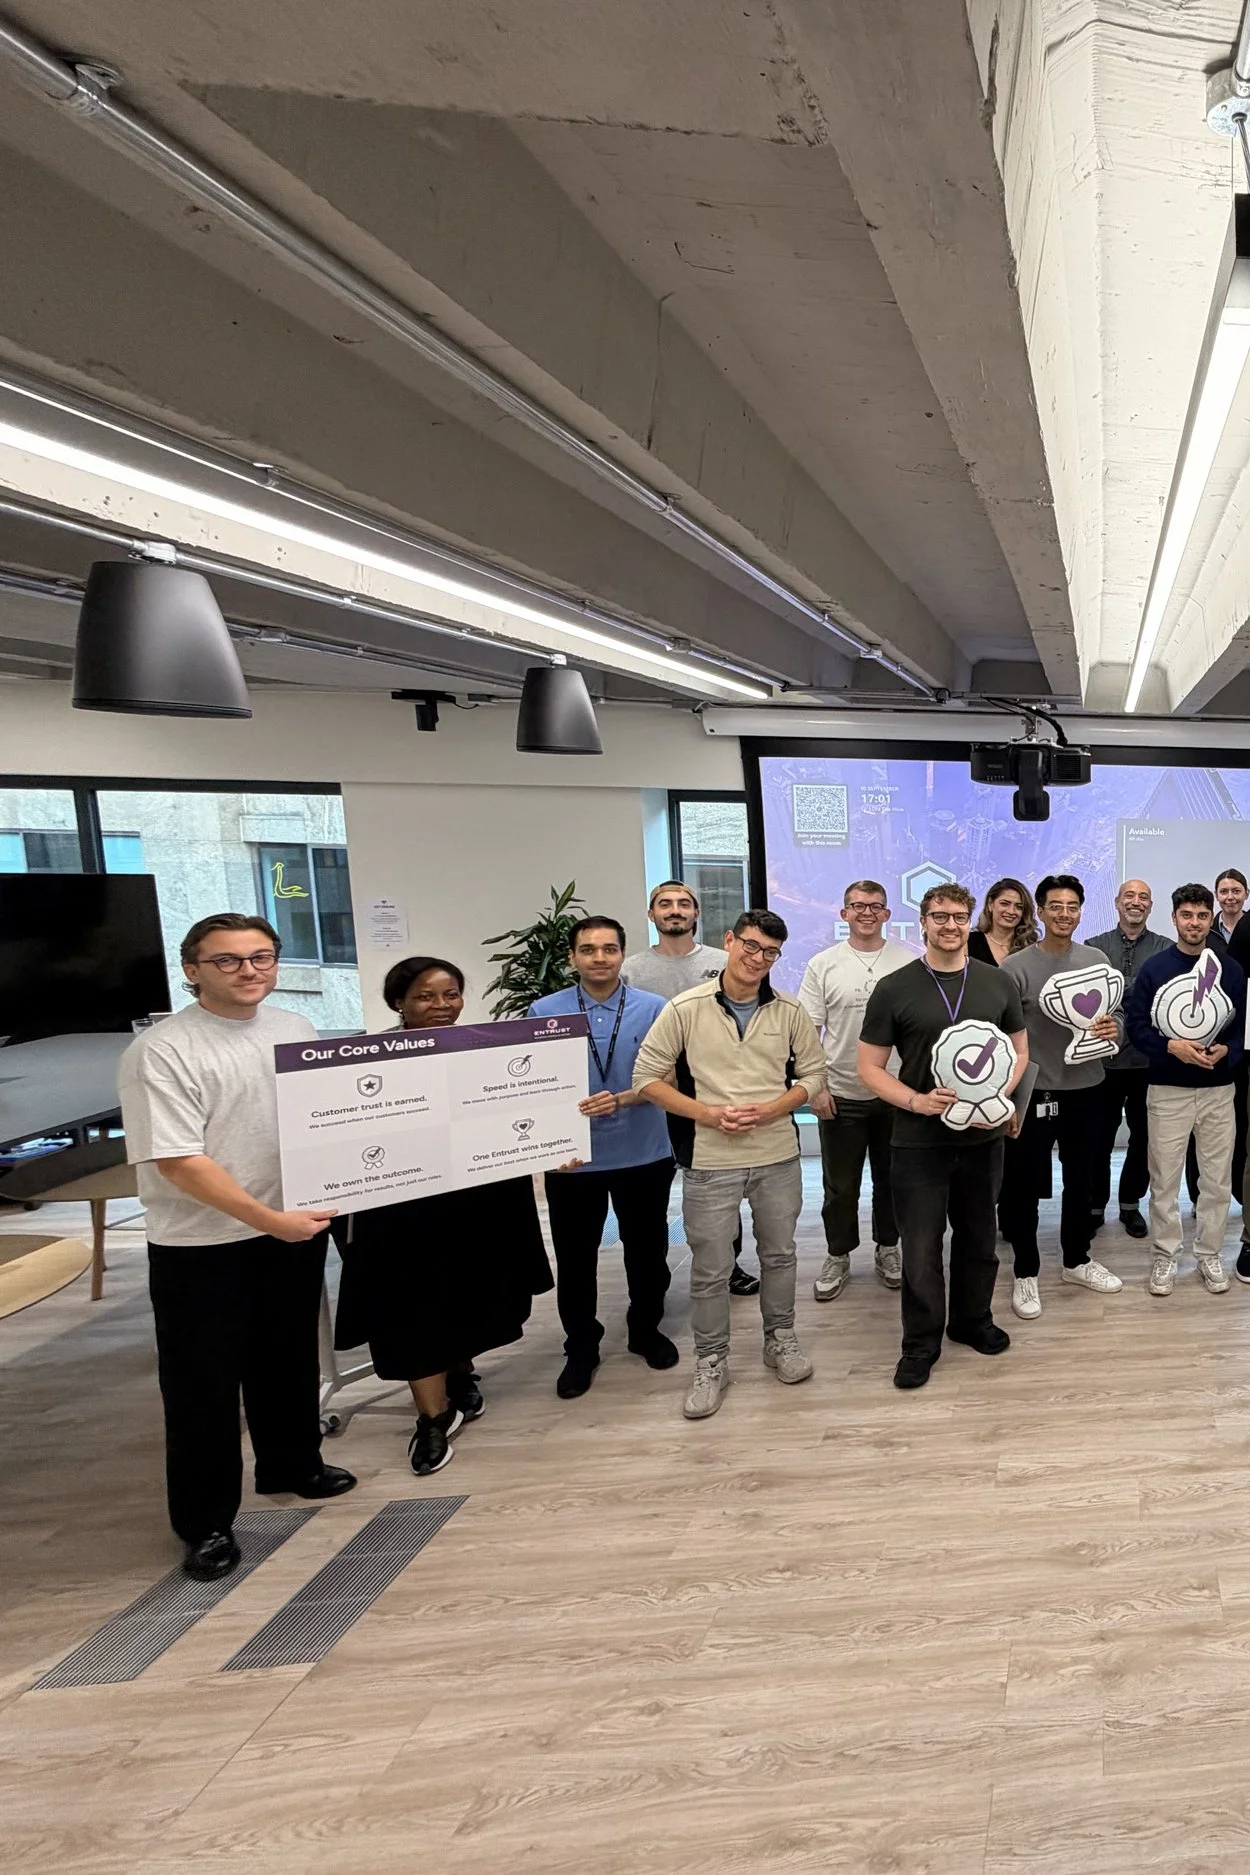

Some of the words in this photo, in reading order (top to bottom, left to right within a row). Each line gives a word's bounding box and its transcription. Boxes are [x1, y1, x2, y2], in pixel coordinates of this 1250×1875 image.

[861, 794, 891, 803] 17:01
[1129, 828, 1165, 836] Available
[534, 1027, 571, 1036] ENTRUST
[301, 1048, 335, 1062] Our
[339, 1044, 380, 1057] Core
[383, 1038, 435, 1052] Values
[483, 1083, 508, 1093] Speed
[518, 1076, 559, 1087] intentional.
[311, 1106, 359, 1118] Customer
[360, 1102, 383, 1111] trust
[394, 1095, 427, 1106] earned.
[472, 1154, 490, 1162] One
[491, 1148, 519, 1158] Entrust
[521, 1144, 539, 1152] wins
[540, 1137, 574, 1149] together.
[324, 1183, 340, 1191] We
[342, 1178, 363, 1187] own
[364, 1174, 381, 1183] the
[382, 1166, 424, 1180] outcome.
[323, 1190, 363, 1202] responsibility
[406, 1179, 417, 1187] just
